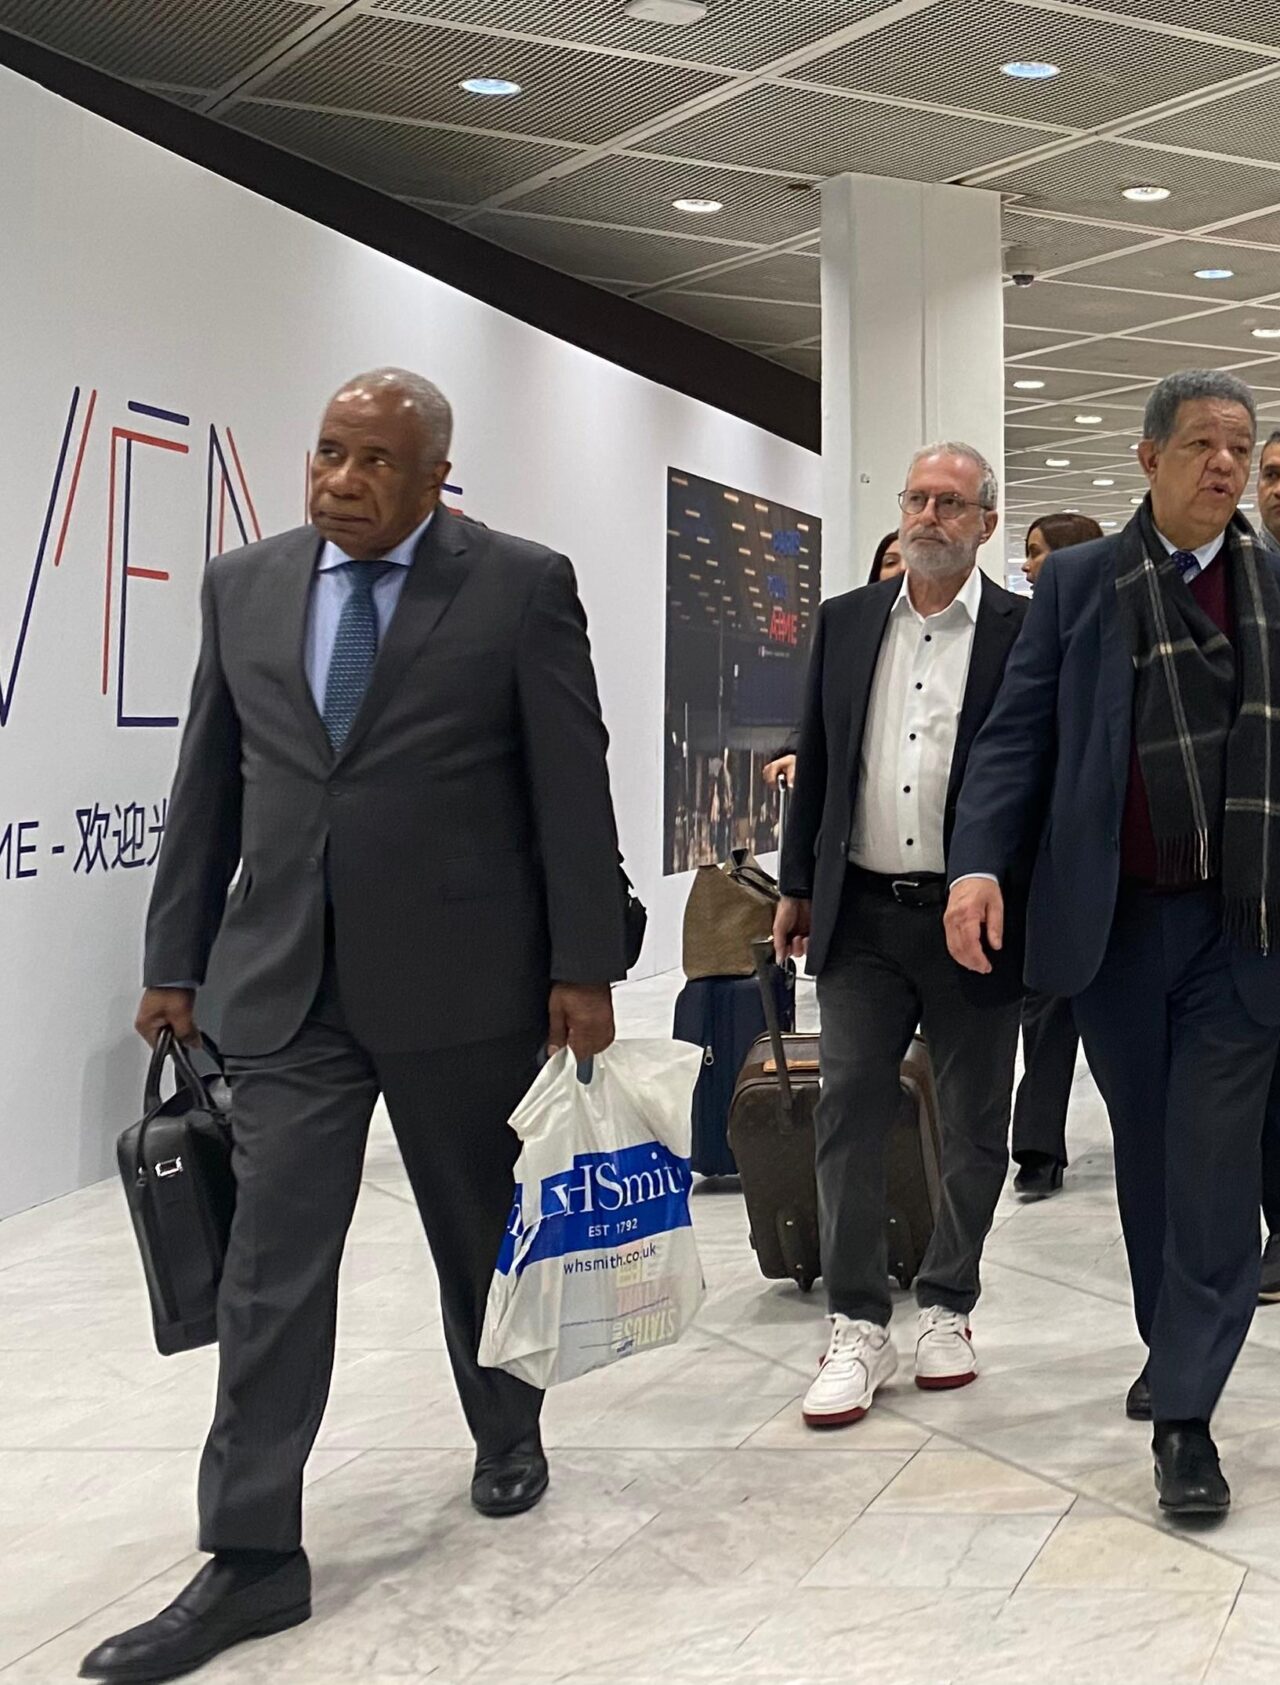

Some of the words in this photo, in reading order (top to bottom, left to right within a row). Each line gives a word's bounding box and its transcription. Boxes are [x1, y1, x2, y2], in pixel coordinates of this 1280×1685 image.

[588, 1224, 610, 1238] EST
[616, 1218, 638, 1235] 1792
[563, 1243, 657, 1275] whsmith.co.uk
